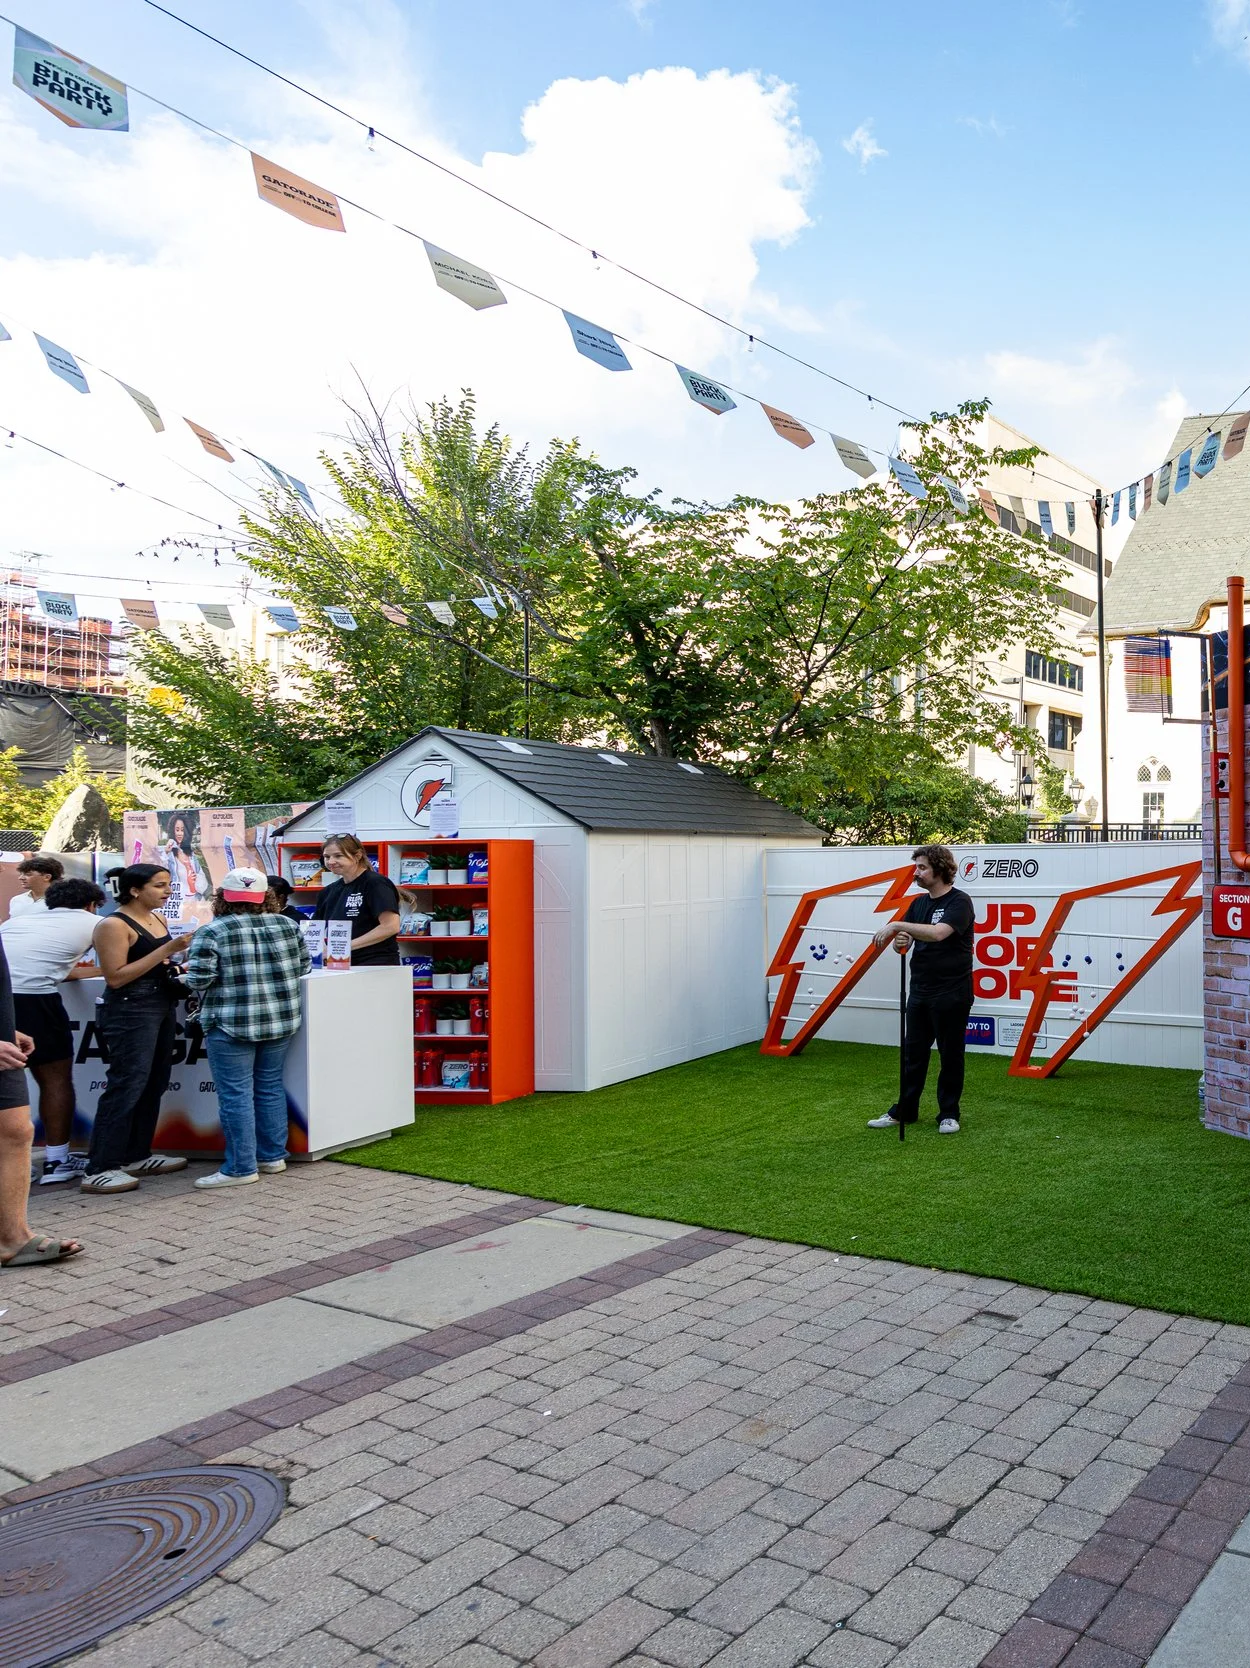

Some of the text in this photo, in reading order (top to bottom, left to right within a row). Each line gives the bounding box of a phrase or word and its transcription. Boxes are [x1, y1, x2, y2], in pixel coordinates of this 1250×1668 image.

[34, 61, 112, 107] BLOCK
[32, 73, 113, 117] PARTY
[262, 174, 334, 209] GATORADE
[688, 378, 721, 394] BLOCK
[693, 387, 727, 402] PARTY
[45, 601, 72, 611] BLOCK
[46, 607, 73, 617] PARTY
[982, 859, 1039, 878] ZERO
[1219, 893, 1250, 904] SECTION
[1226, 906, 1242, 932] G
[979, 1023, 990, 1031] TO
